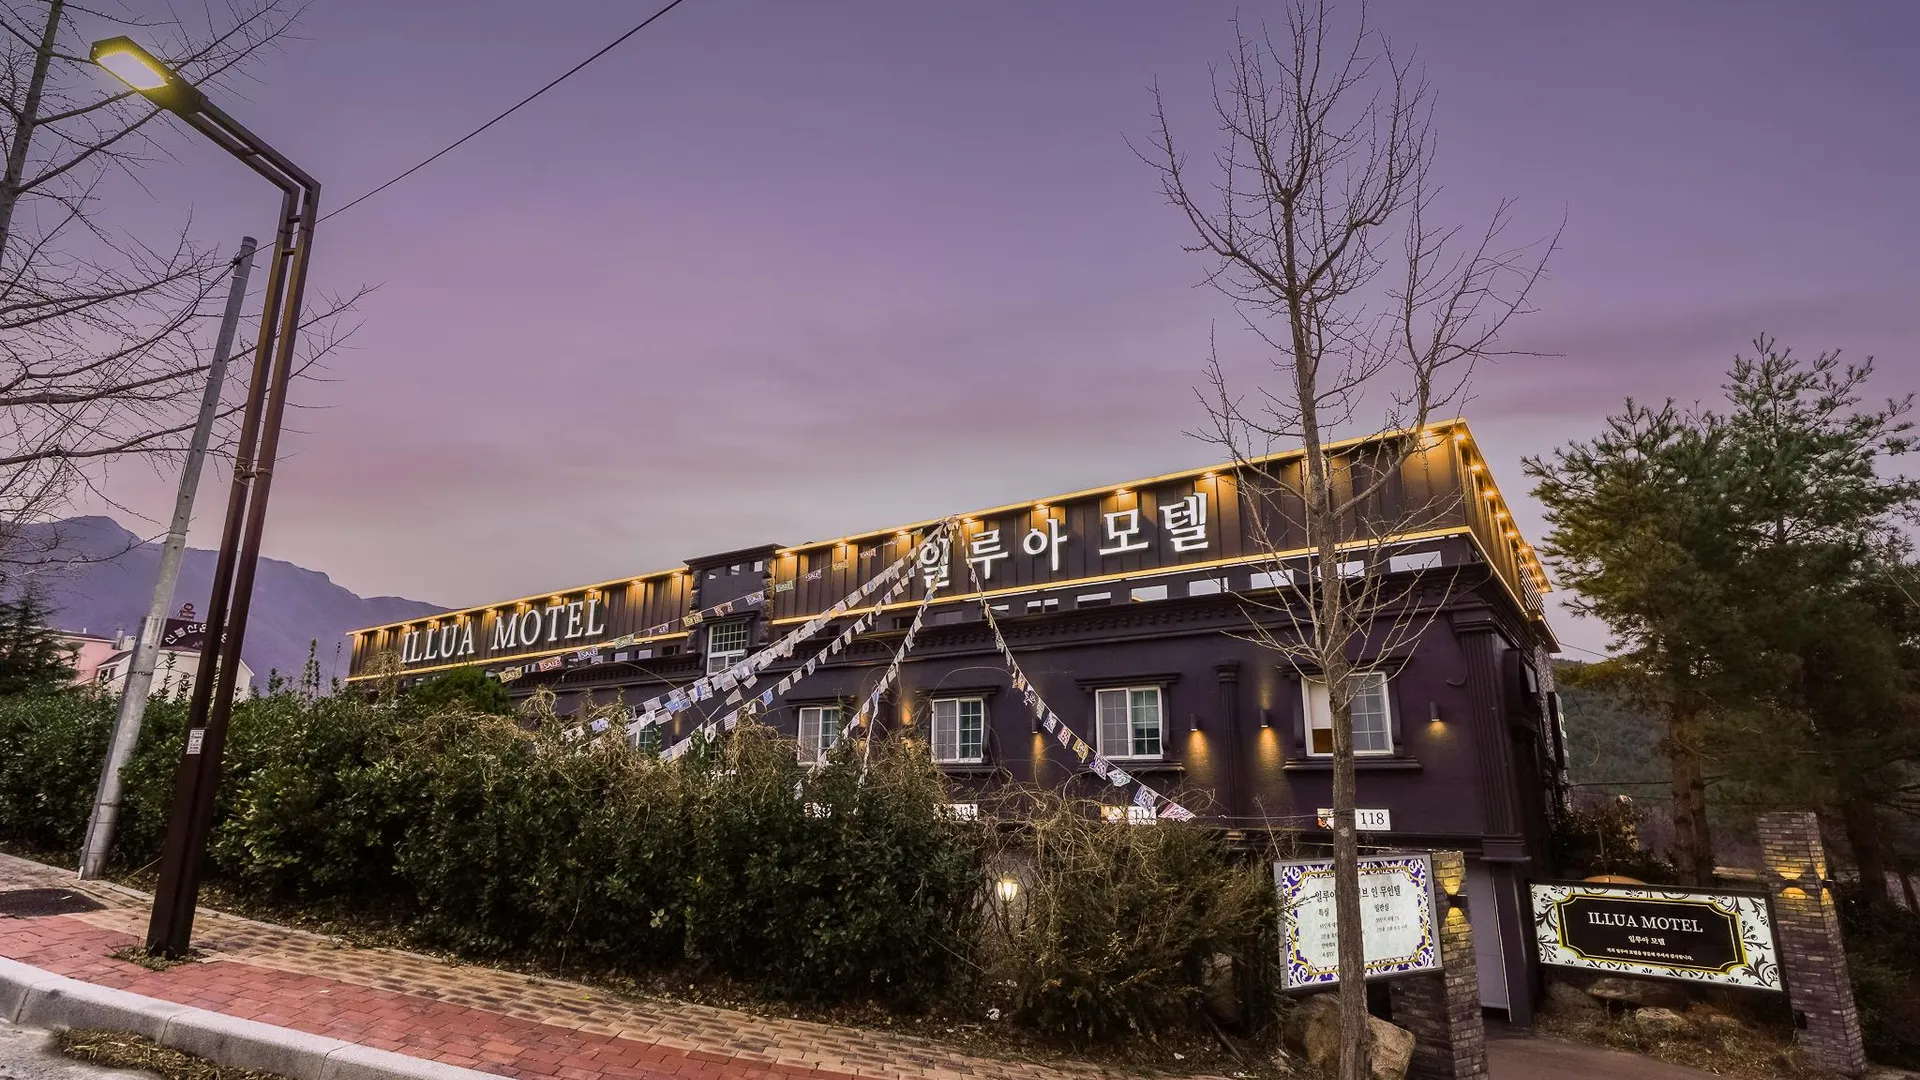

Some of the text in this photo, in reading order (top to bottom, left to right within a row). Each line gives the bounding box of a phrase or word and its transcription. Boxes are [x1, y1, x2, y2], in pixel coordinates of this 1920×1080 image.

[919, 492, 1209, 589] 일루아 모텔
[400, 598, 604, 664] ILLUA MOTEL
[580, 647, 598, 658] SALE
[543, 659, 562, 670] SALE
[1361, 812, 1385, 826] 118
[1370, 886, 1378, 898] 인
[1379, 884, 1401, 897] 무인텔
[1587, 911, 1703, 933] ILLUA MOTEL
[1628, 935, 1666, 946] 일루아 모텔
